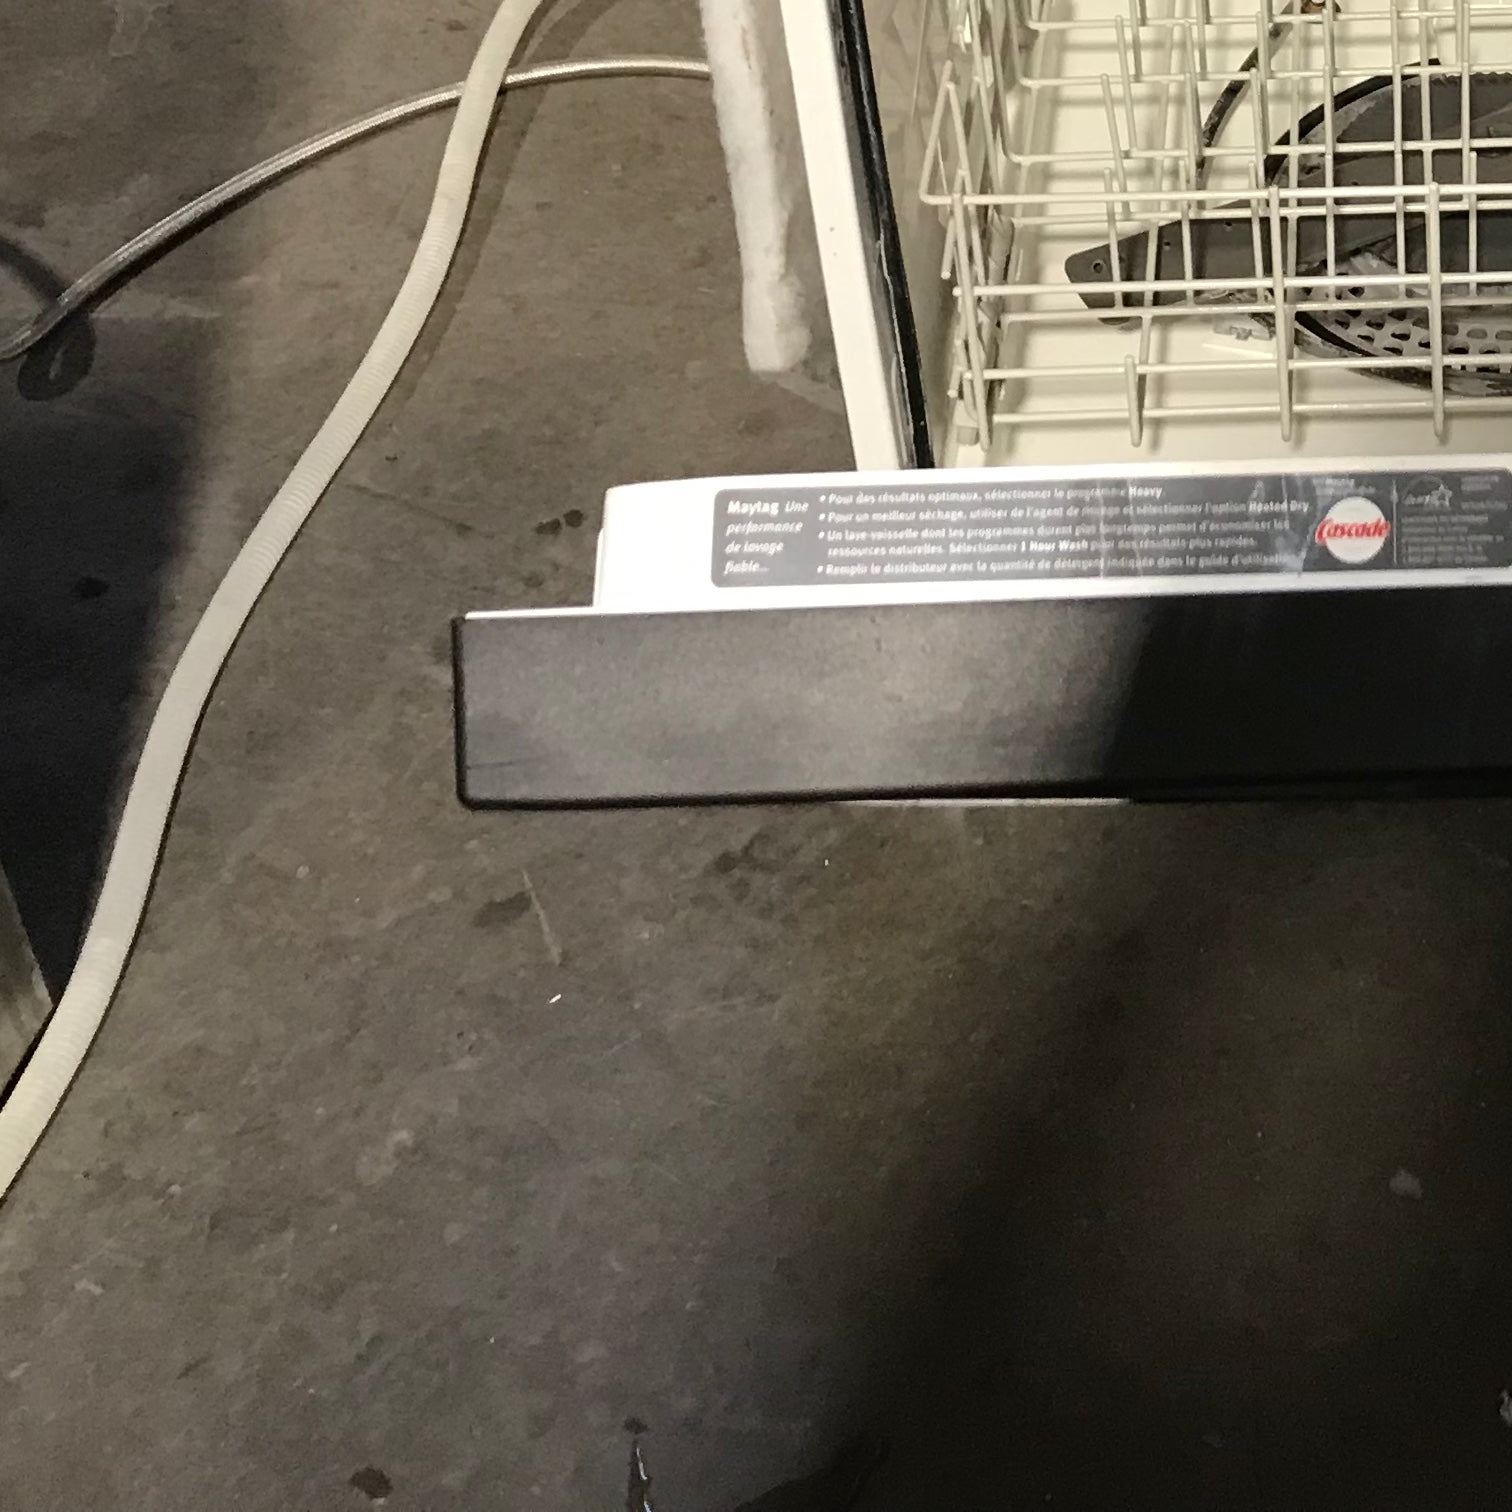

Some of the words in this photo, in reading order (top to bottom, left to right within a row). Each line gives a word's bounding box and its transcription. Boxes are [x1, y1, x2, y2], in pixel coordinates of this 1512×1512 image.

[727, 501, 780, 516] Maytag
[725, 520, 804, 537] performance
[1316, 518, 1391, 545] Cascade
